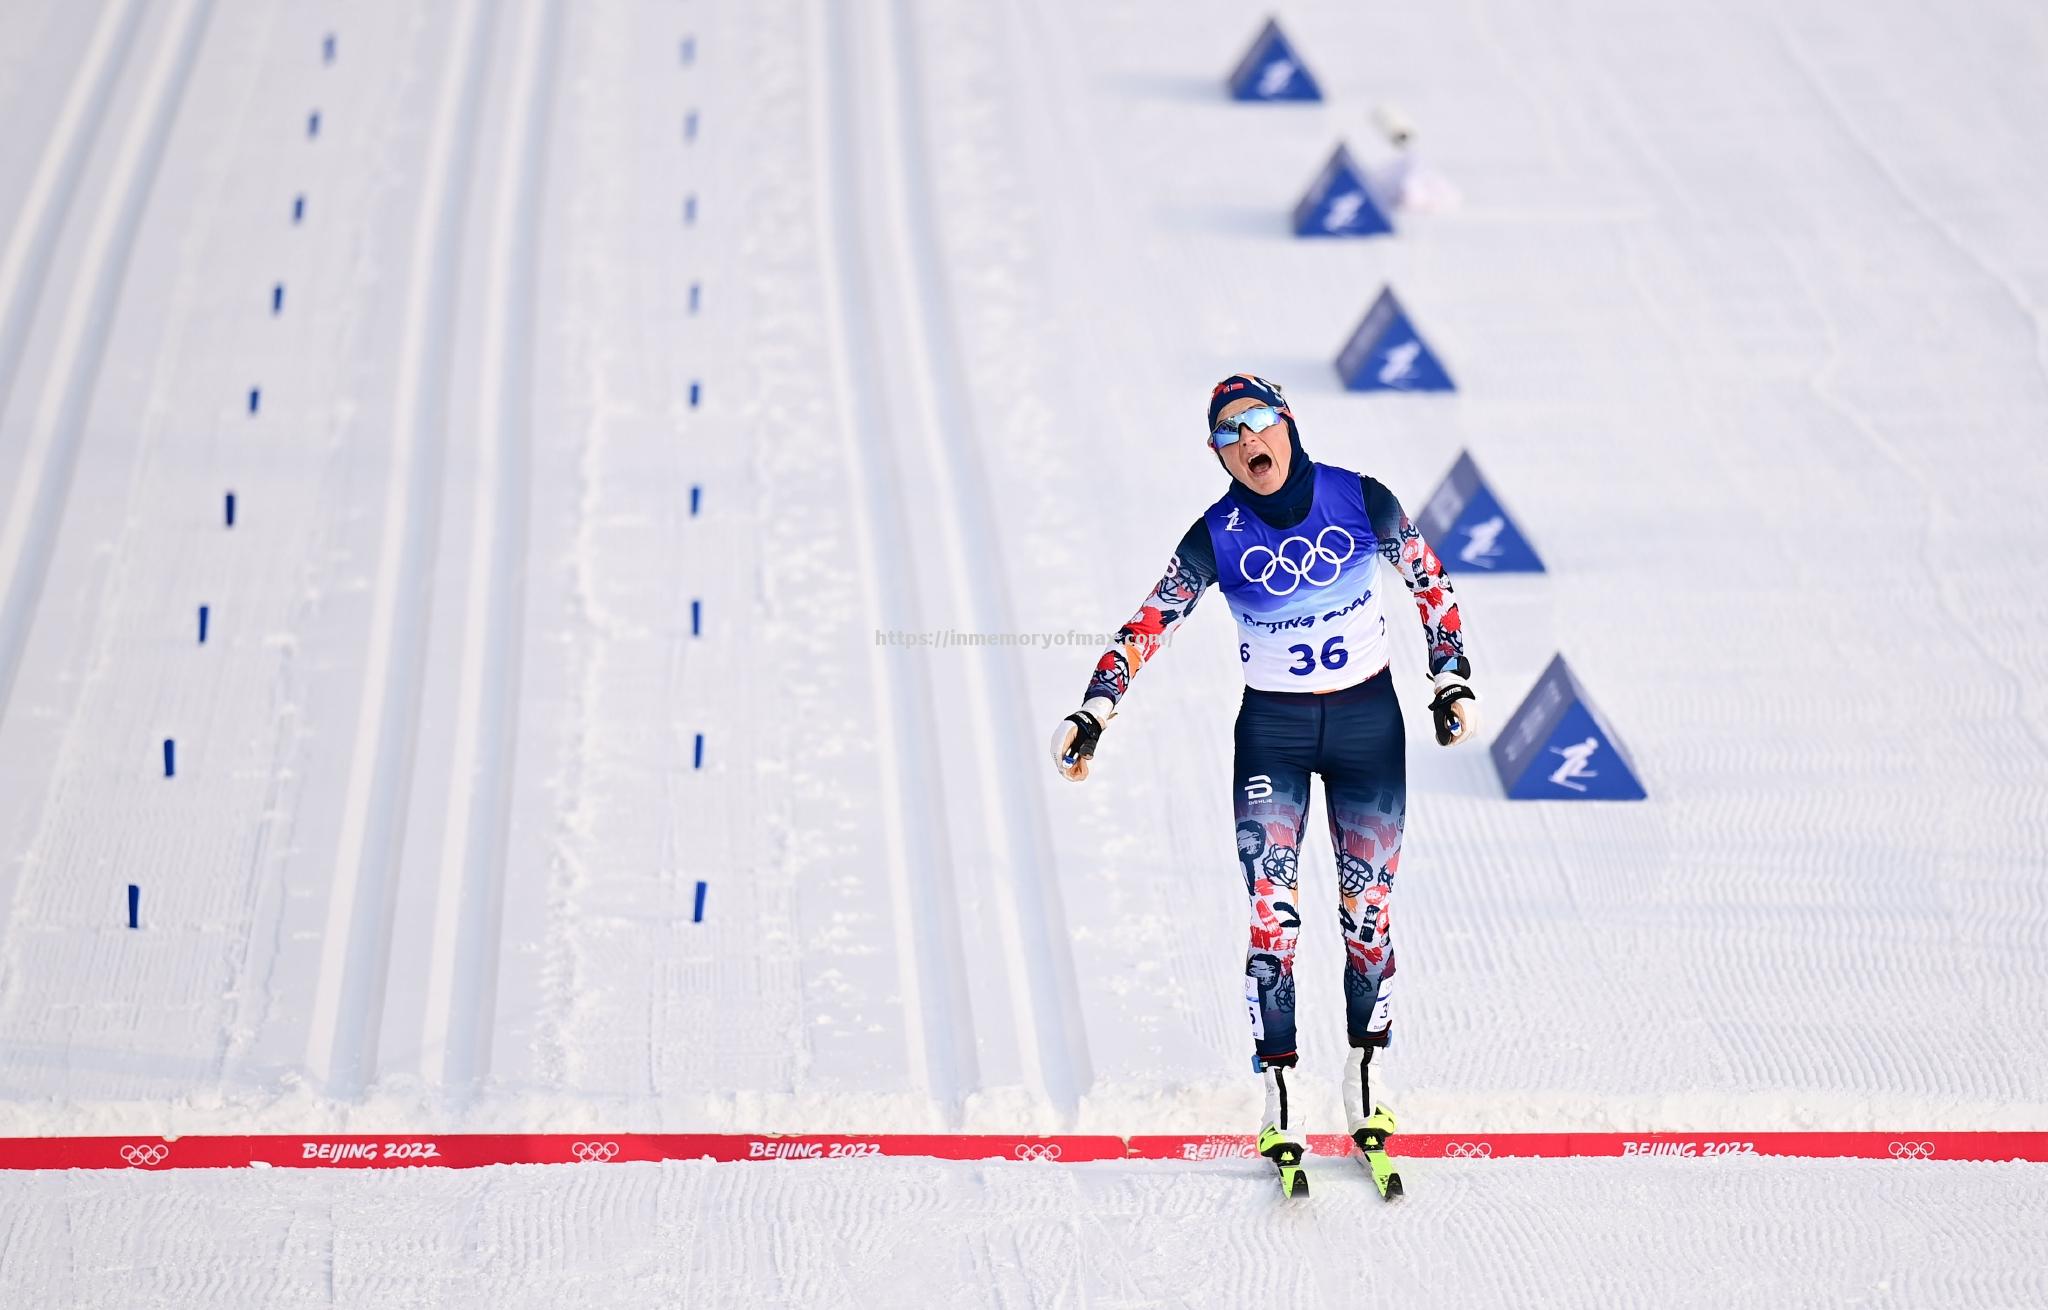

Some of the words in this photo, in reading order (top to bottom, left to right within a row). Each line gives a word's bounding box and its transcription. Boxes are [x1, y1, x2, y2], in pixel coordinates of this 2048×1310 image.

[1288, 635, 1349, 676] 36
[302, 1142, 378, 1164] BEIJING
[383, 1142, 442, 1159] 2022
[748, 1141, 824, 1160] BEIJING
[828, 1142, 886, 1158] 2022
[1702, 1141, 1759, 1157] 2022
